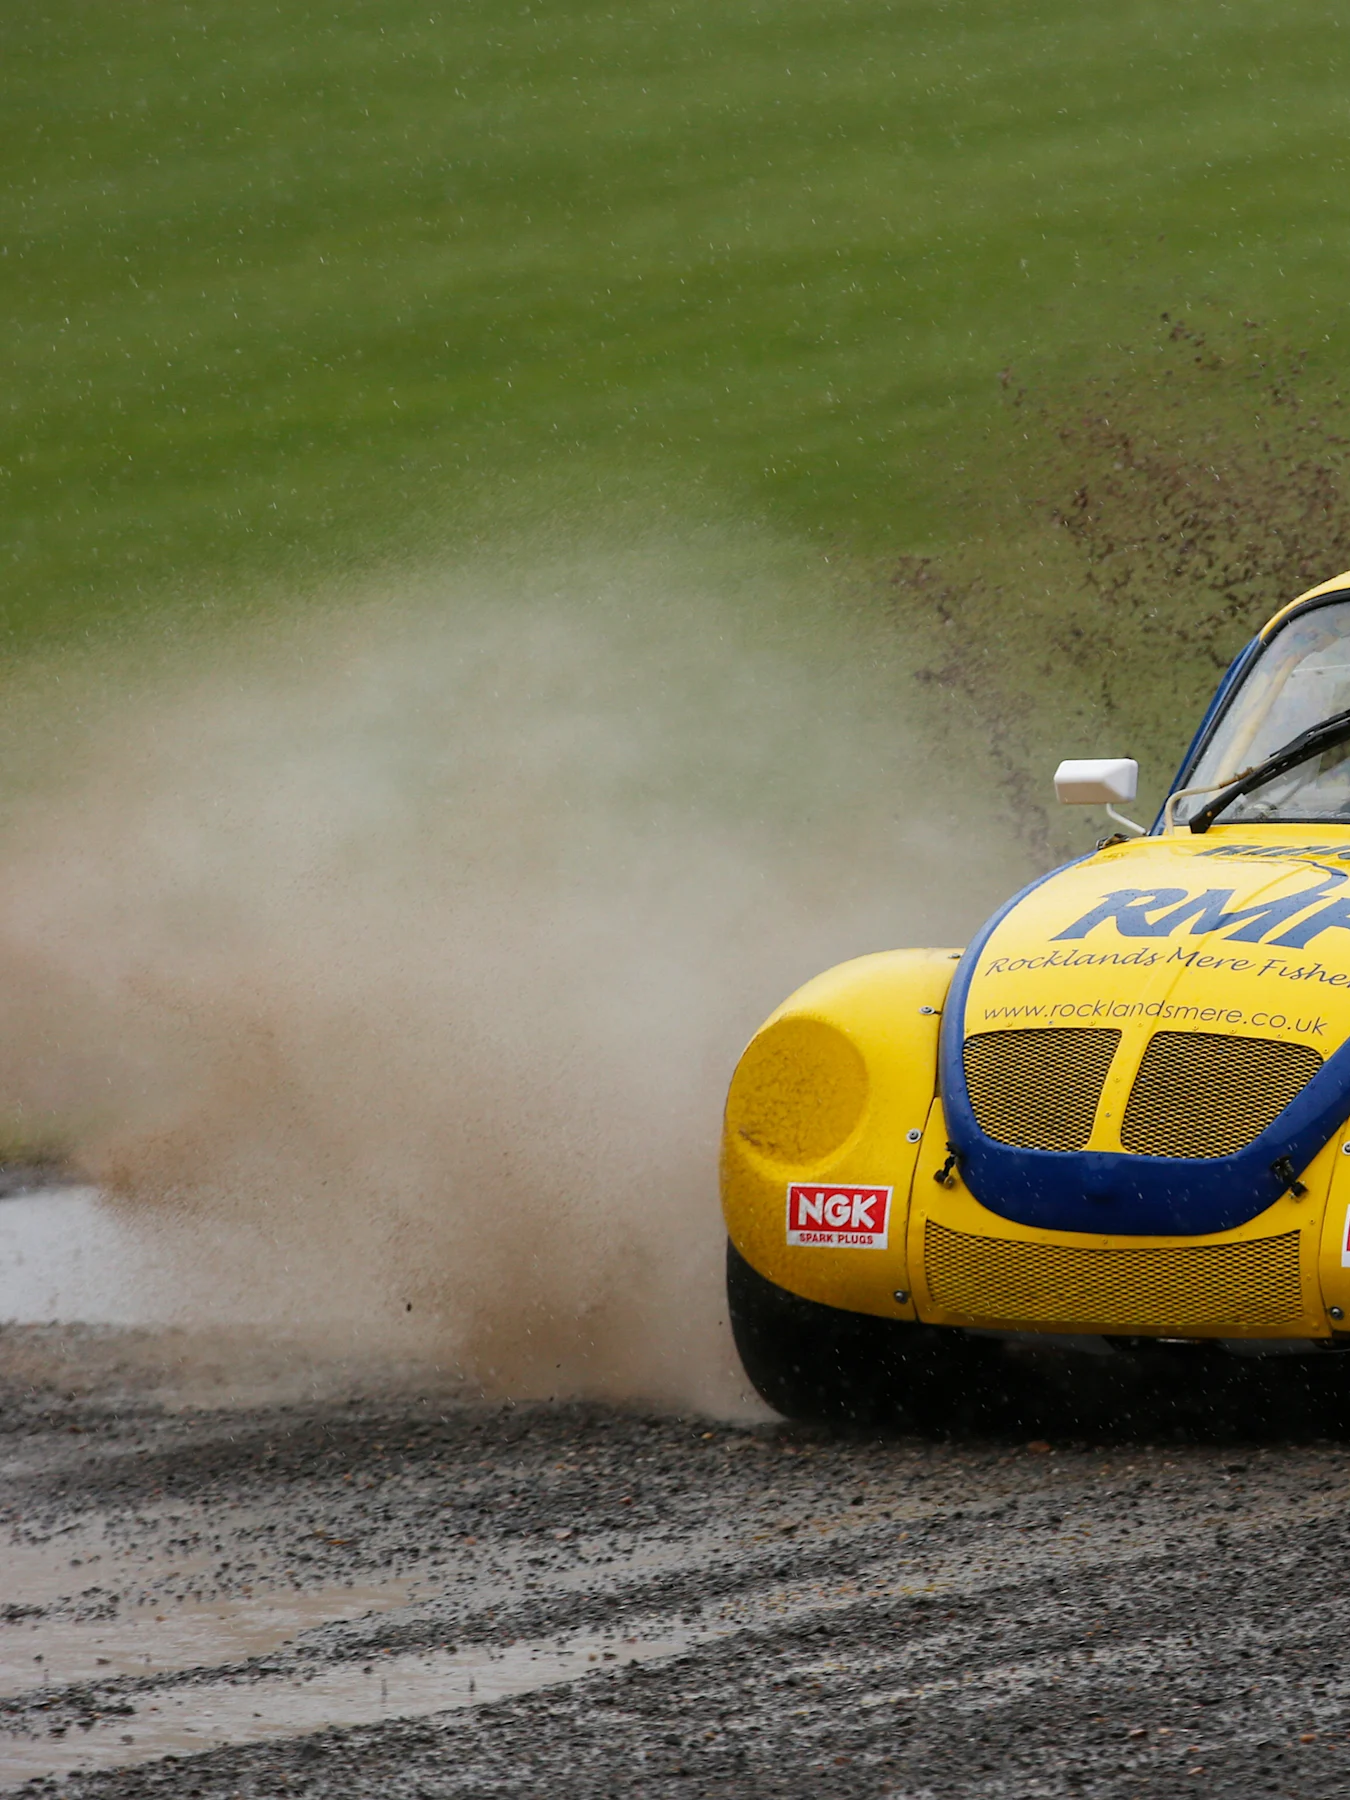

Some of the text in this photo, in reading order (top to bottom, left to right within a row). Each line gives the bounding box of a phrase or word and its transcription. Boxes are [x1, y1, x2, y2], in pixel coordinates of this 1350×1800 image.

[985, 947, 1166, 977] Rocklands
[1166, 946, 1256, 971] Mere
[984, 999, 1329, 1037] www.rocklandsmere.co.uk
[797, 1192, 878, 1230] NGK
[799, 1232, 874, 1245] SPARK PLUGS
